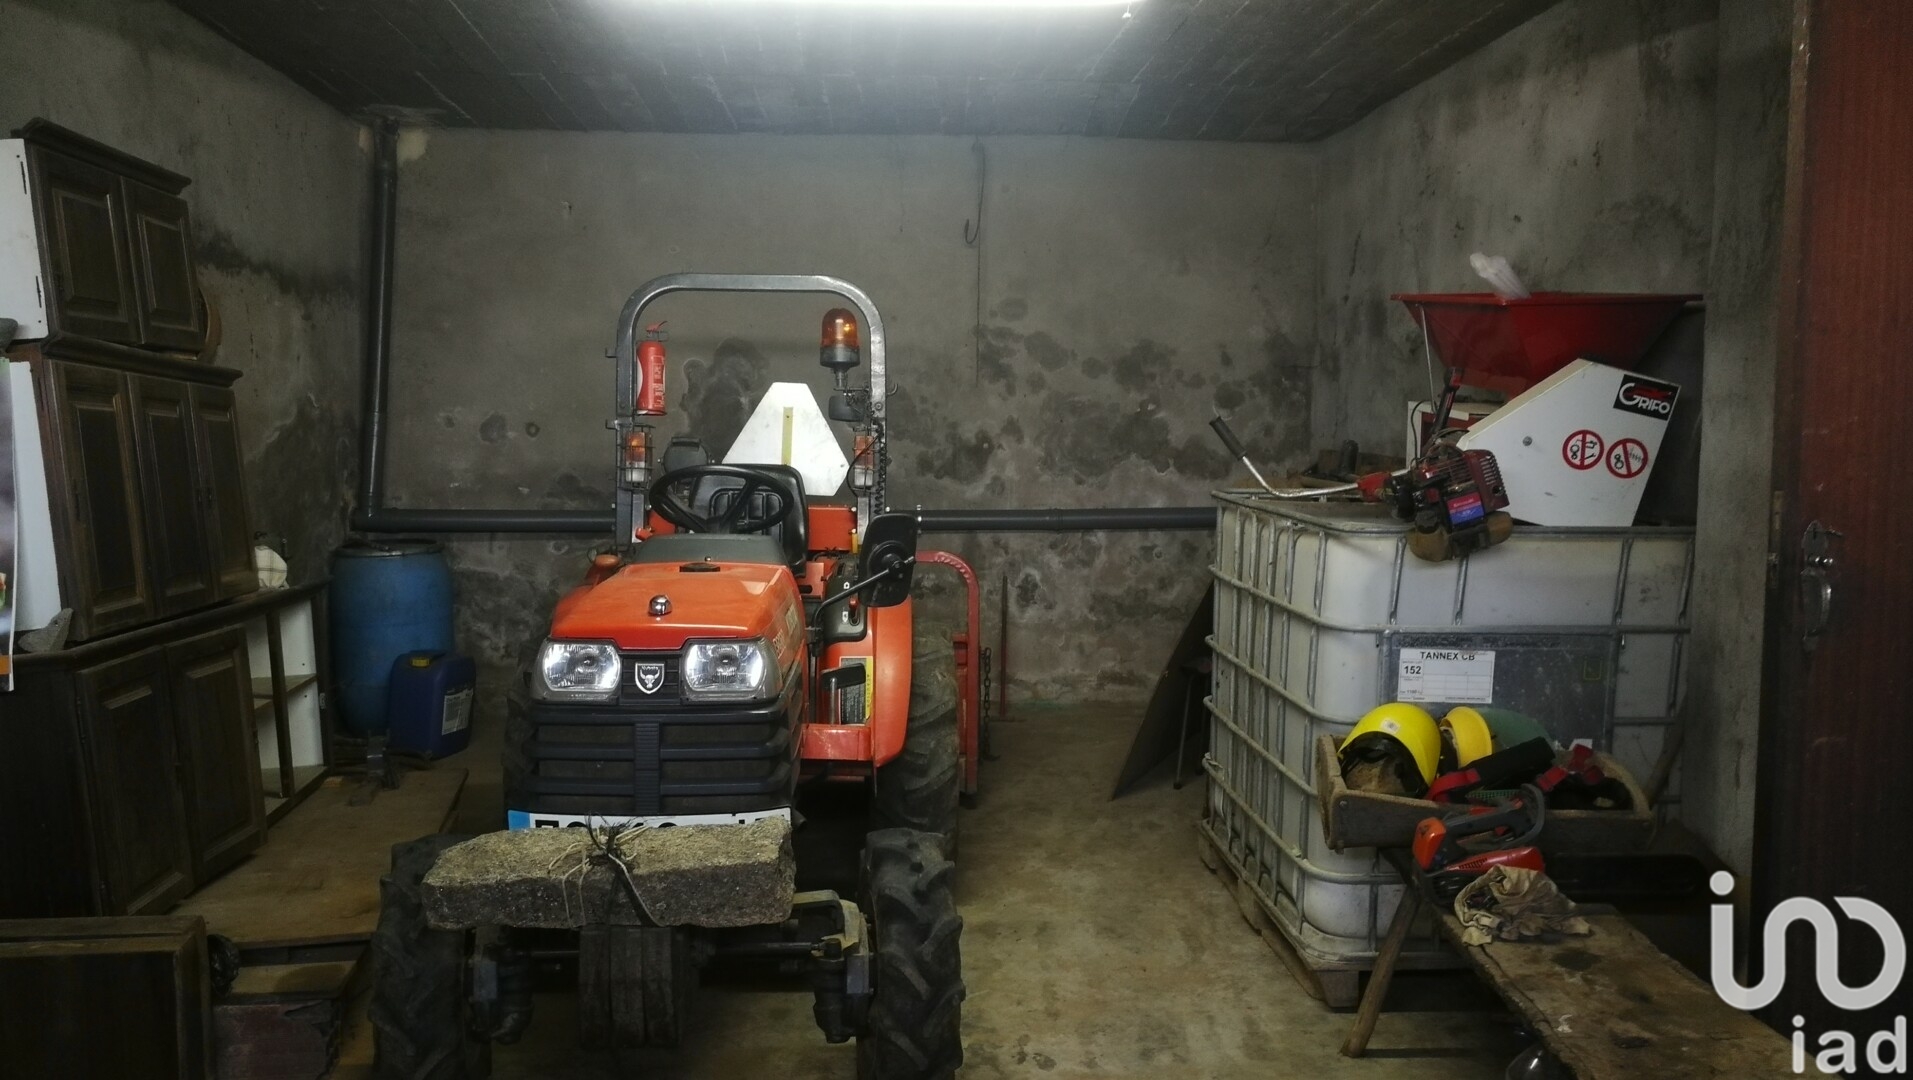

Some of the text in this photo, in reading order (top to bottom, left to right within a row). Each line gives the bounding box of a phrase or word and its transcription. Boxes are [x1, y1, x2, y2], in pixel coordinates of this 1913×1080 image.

[1619, 382, 1670, 414] GRIFO
[1420, 651, 1459, 661] TANNEX
[1404, 666, 1421, 675] 152
